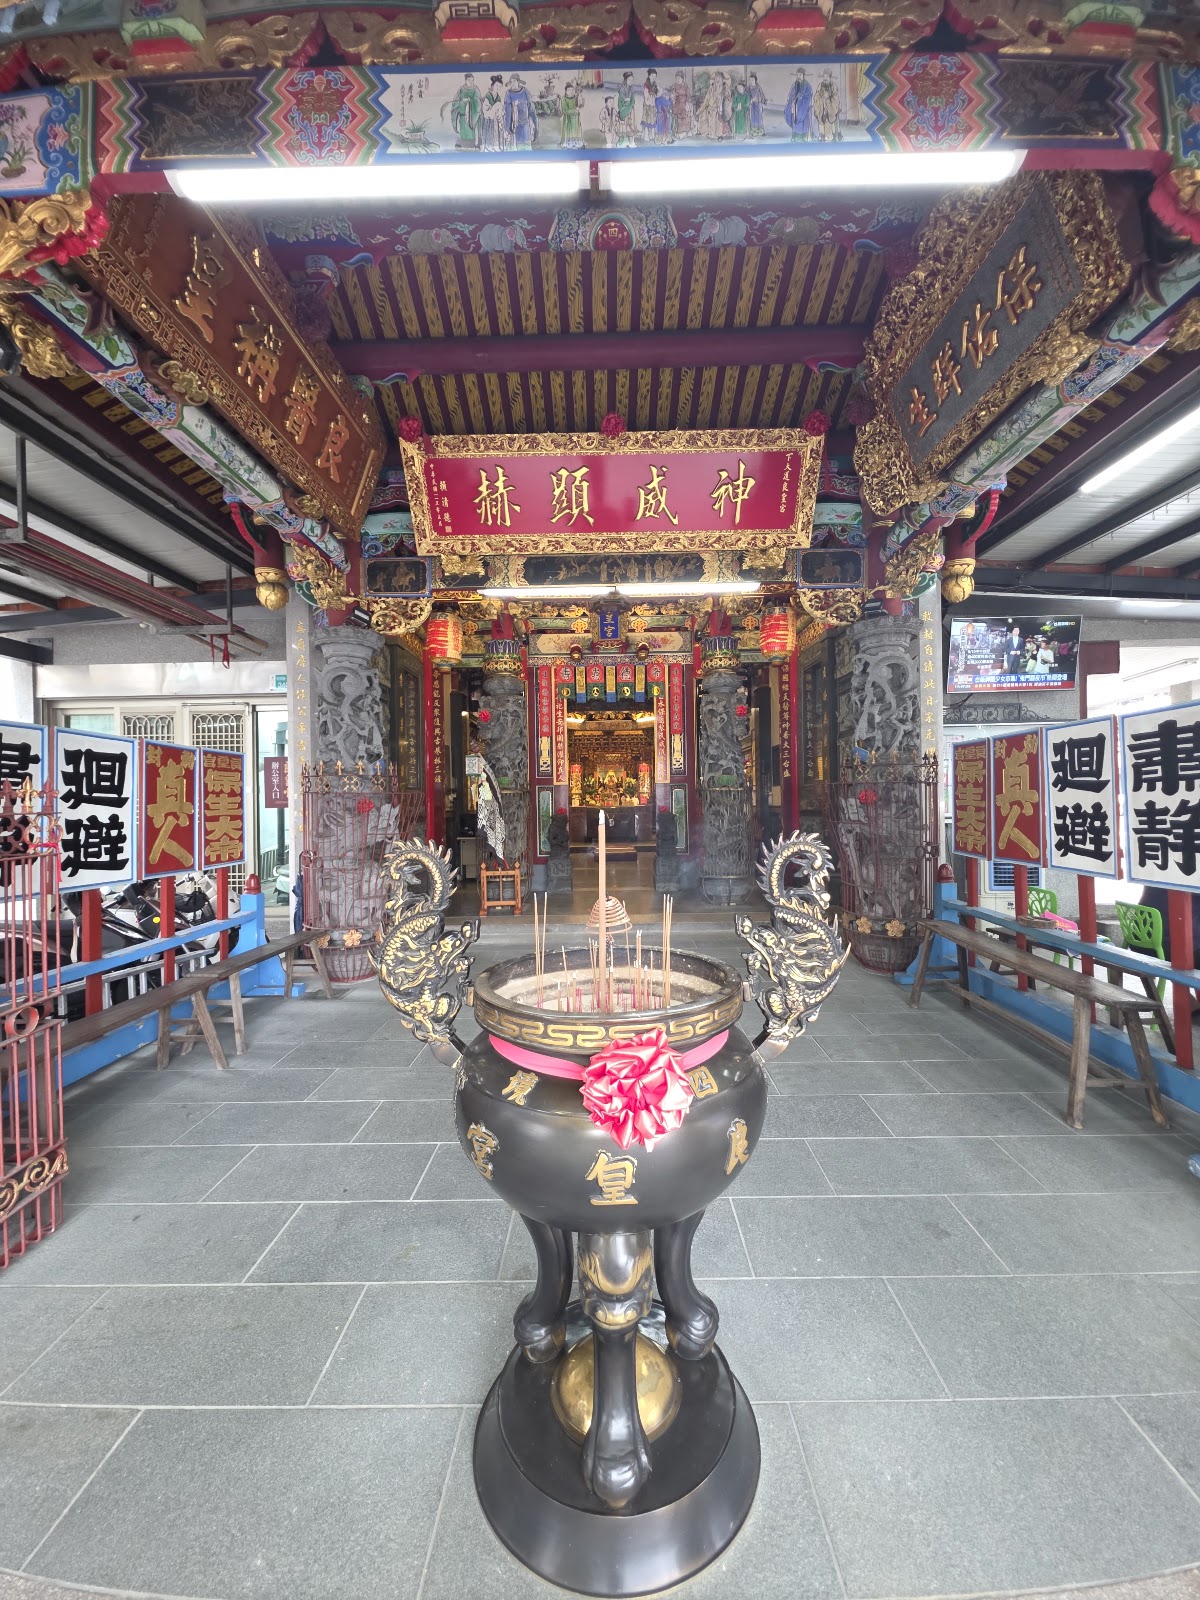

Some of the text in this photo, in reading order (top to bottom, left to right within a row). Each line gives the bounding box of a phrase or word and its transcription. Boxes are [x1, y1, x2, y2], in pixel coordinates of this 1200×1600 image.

[473, 459, 756, 527] 神威顯赫
[780, 452, 794, 513] 下大道良皇宮
[60, 747, 130, 877] 迴避
[148, 758, 194, 867] 真人
[204, 769, 243, 862] 保生大帝
[271, 761, 280, 799] 辦公室入口
[955, 760, 986, 852] 保生大帝
[995, 749, 1040, 859] 真人
[1051, 732, 1114, 862] 迴避
